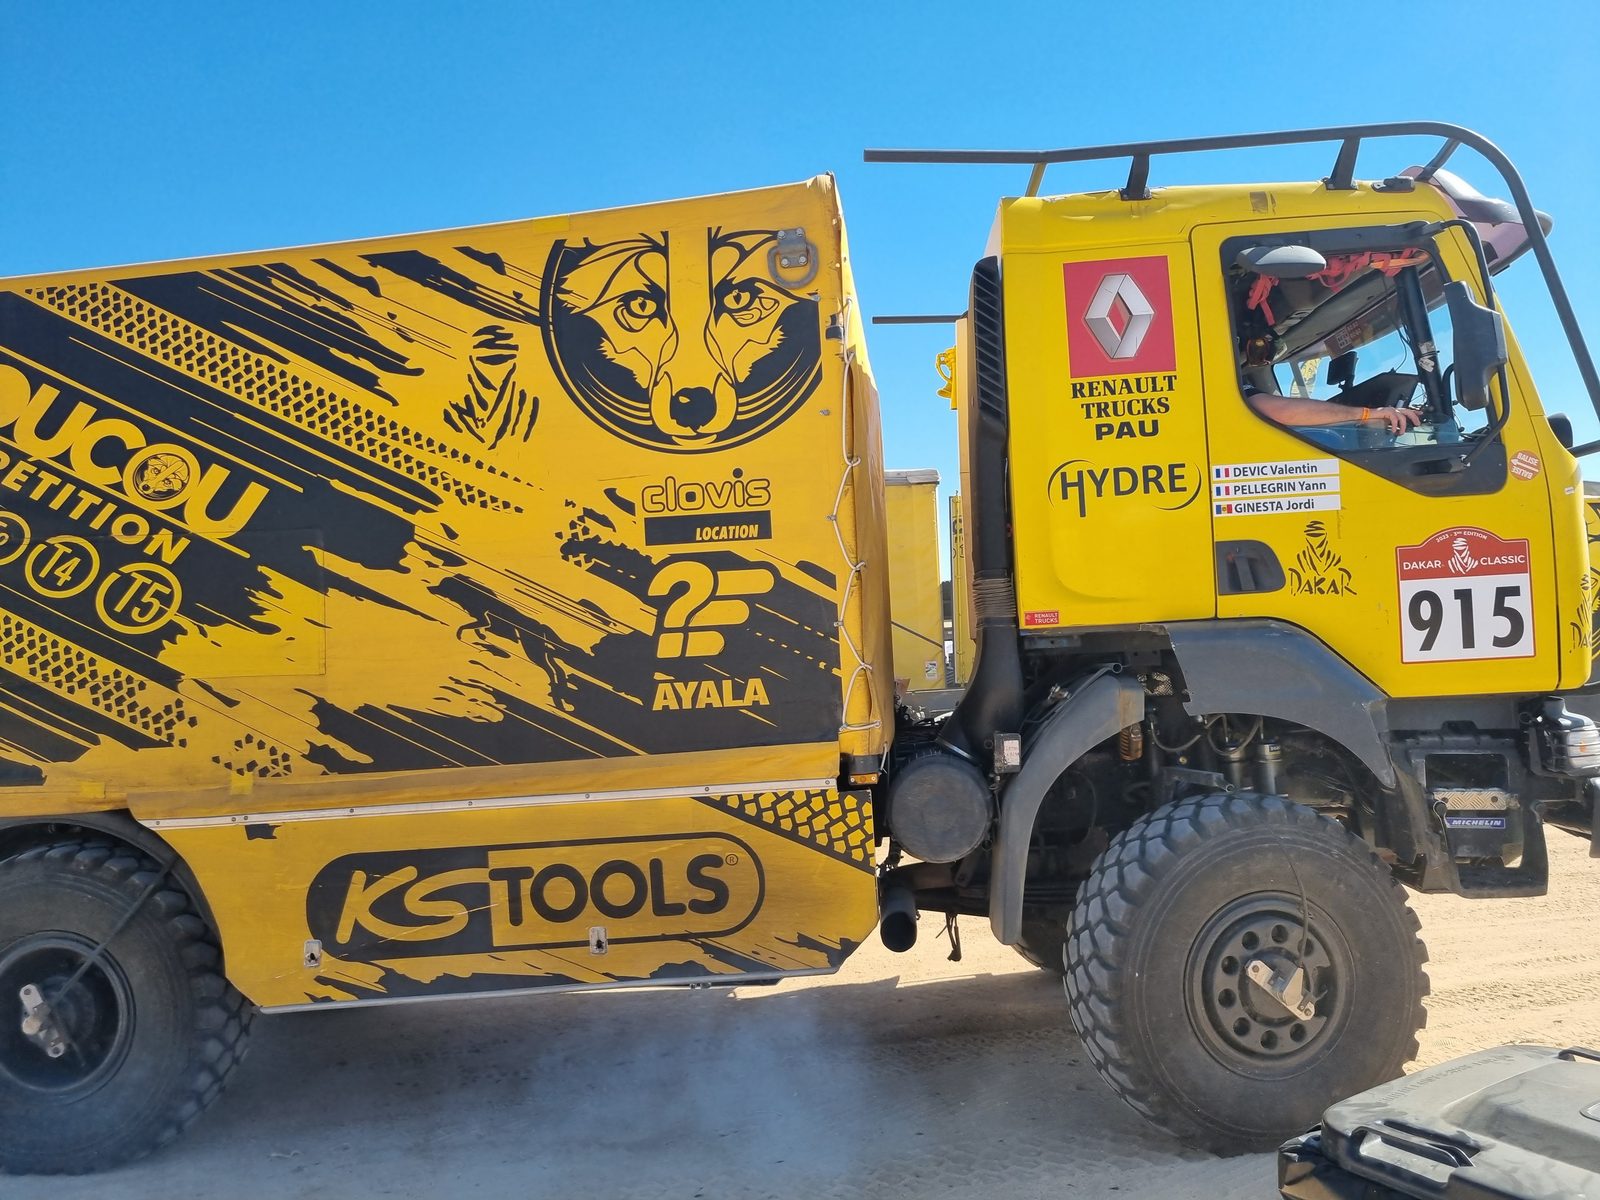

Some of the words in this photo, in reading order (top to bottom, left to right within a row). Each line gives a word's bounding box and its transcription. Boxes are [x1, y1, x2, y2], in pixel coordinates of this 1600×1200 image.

[1071, 375, 1177, 399] RENAULT
[1081, 396, 1170, 420] TRUCKS
[1095, 419, 1160, 440] PAU
[1517, 452, 1539, 466] BALISE
[1233, 465, 1268, 478] DEVIC
[1270, 463, 1318, 476] Valentin
[642, 467, 771, 513] clovis
[1060, 463, 1187, 518] HYDRE
[1234, 482, 1296, 495] PELLEGRIN
[1298, 481, 1327, 492] Yann
[1234, 501, 1284, 513] GINESTA
[1285, 499, 1315, 511] Jordi
[695, 524, 759, 541] LOCATION
[1463, 531, 1488, 540] EDITION
[39, 543, 81, 586] T4
[1403, 559, 1442, 571] DAKAR
[1480, 555, 1526, 566] CLASSIC
[1288, 567, 1357, 597] DAKAR
[114, 572, 171, 623] T5
[1034, 617, 1058, 625] TRUCKS
[1408, 585, 1525, 652] 915
[652, 677, 770, 711] AYALA
[1452, 819, 1502, 827] MICHELIN
[336, 864, 489, 945] KS
[488, 853, 730, 927] TOOLS
